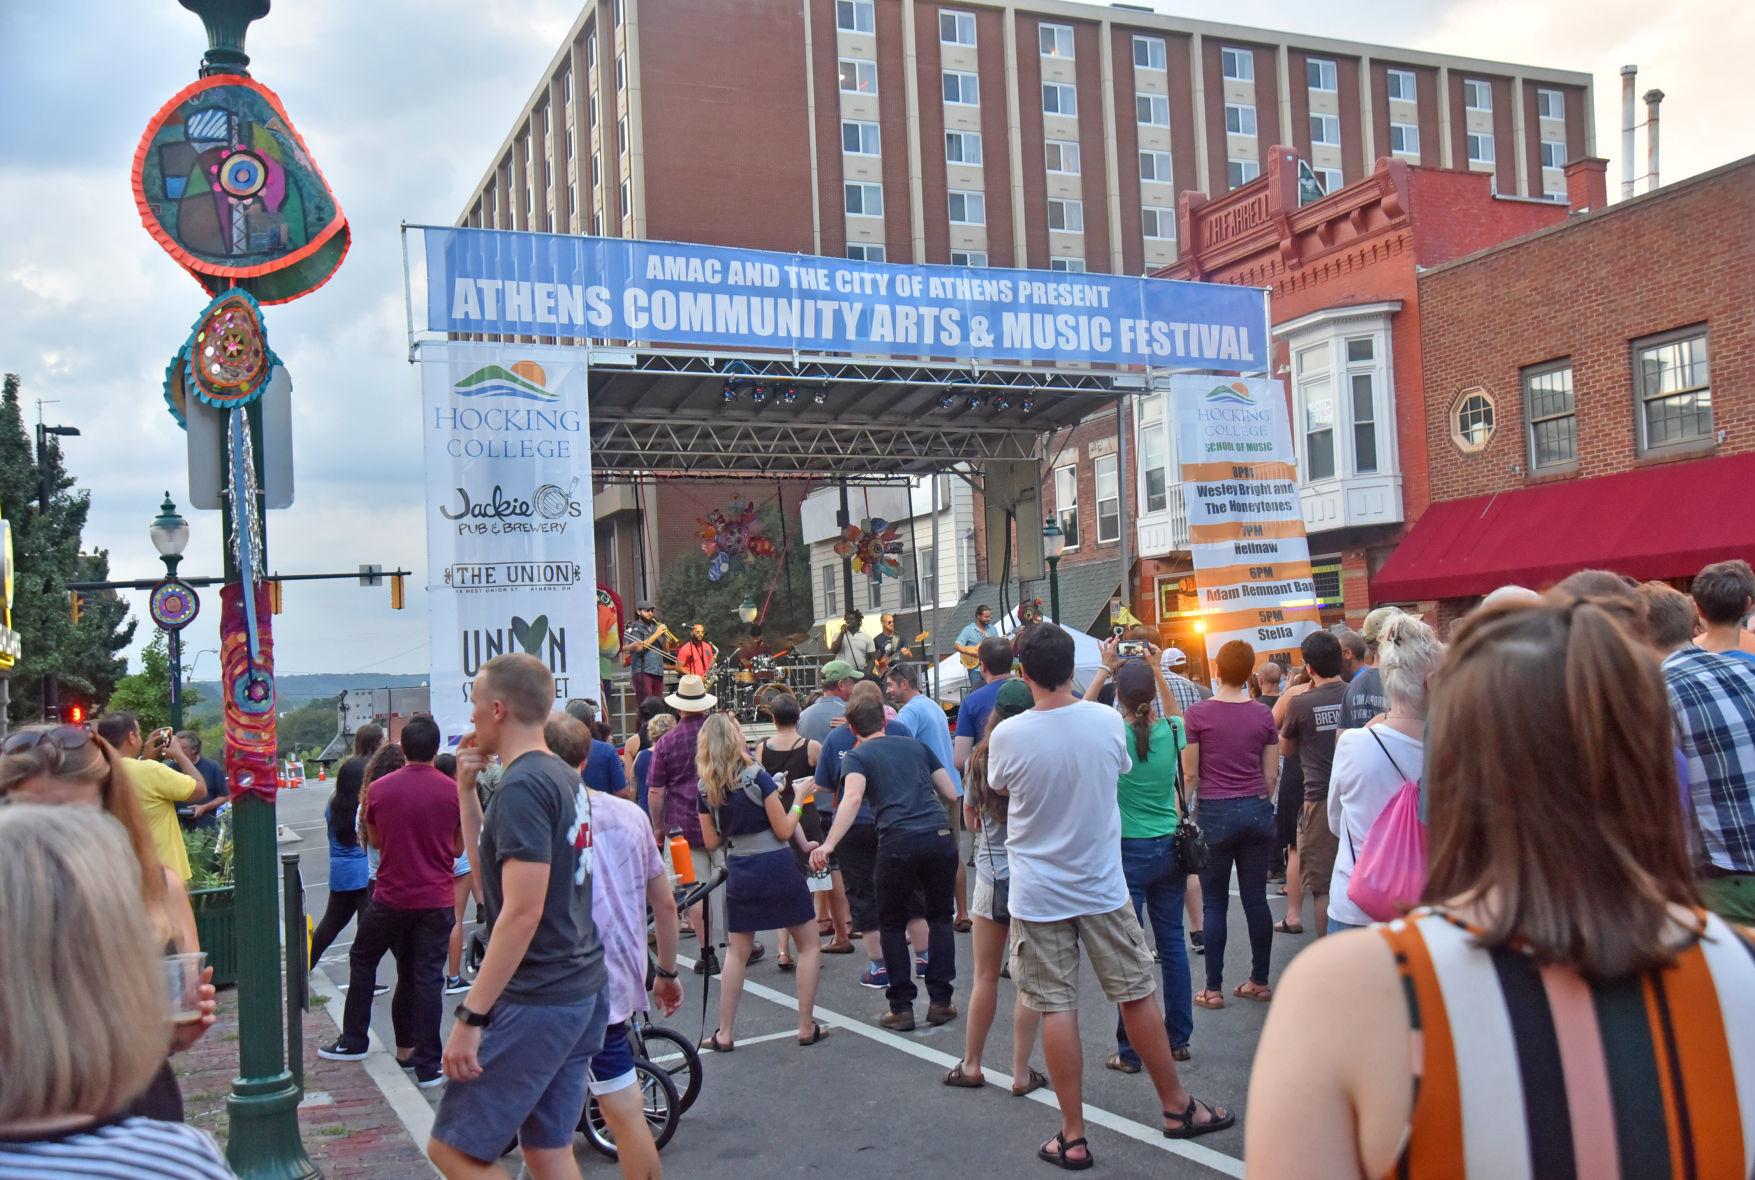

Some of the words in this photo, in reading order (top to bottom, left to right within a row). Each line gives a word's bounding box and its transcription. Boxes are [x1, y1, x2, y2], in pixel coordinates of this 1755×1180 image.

[646, 254, 722, 283] AMAC
[728, 260, 780, 288] AND
[784, 265, 831, 291] THE
[835, 270, 889, 297] CITY
[895, 274, 923, 298] OF
[929, 276, 1012, 303] ATHENS
[1018, 281, 1110, 308] PRESENT
[451, 277, 612, 327] ATHENS
[623, 287, 861, 340] COMMUNITY
[870, 304, 960, 347] ARTS
[969, 316, 994, 348] &
[1002, 311, 1112, 353] MUSIC
[1121, 317, 1253, 361] FESTIVAL
[435, 406, 580, 432] HOCKING
[1199, 407, 1270, 422] HOCKING
[1205, 424, 1267, 437] COLLEGE
[447, 438, 571, 458] COLLEGE
[1205, 441, 1235, 452] SCHOOL
[1235, 442, 1245, 452] OF
[1246, 442, 1273, 452] MUSIC
[1197, 483, 1238, 498] Wesley
[1239, 482, 1271, 497] Bright
[1273, 482, 1294, 495] and
[439, 484, 535, 522] Jackie
[1205, 502, 1227, 515] The
[1229, 500, 1292, 514] Honeytones
[458, 522, 488, 535] PUB
[491, 522, 501, 534] &
[503, 521, 567, 534] BREWERY
[457, 566, 496, 585] THE
[507, 564, 569, 583] UNION
[1249, 566, 1274, 579] 6PM
[1206, 588, 1240, 602] Adam
[1242, 582, 1293, 598] Remnant
[1259, 610, 1284, 623] 5PM
[1258, 626, 1293, 641] Stella
[463, 615, 567, 678] UNIN
